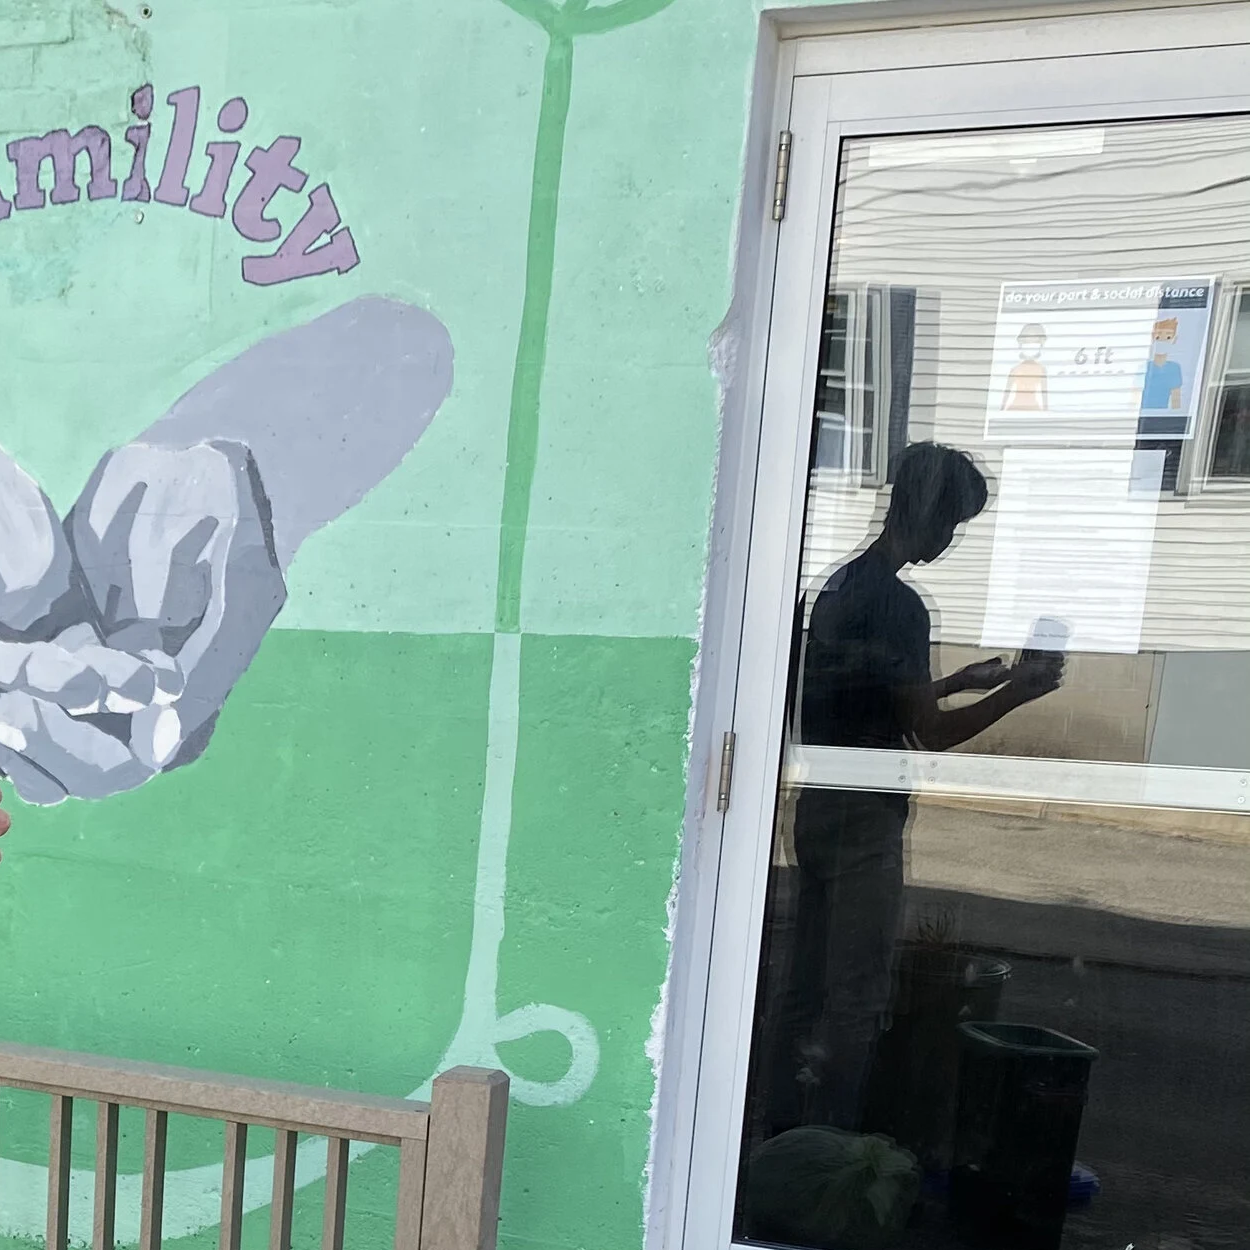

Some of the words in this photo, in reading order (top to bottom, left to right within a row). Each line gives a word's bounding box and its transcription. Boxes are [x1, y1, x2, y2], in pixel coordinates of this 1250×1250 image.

[1005, 290, 1023, 303] do
[1025, 291, 1055, 305] your
[1057, 289, 1088, 304] part
[1090, 288, 1101, 301] &
[1103, 285, 1144, 300] social
[1145, 285, 1205, 298] distance
[1073, 346, 1087, 365] 6
[1094, 345, 1116, 365] ft
